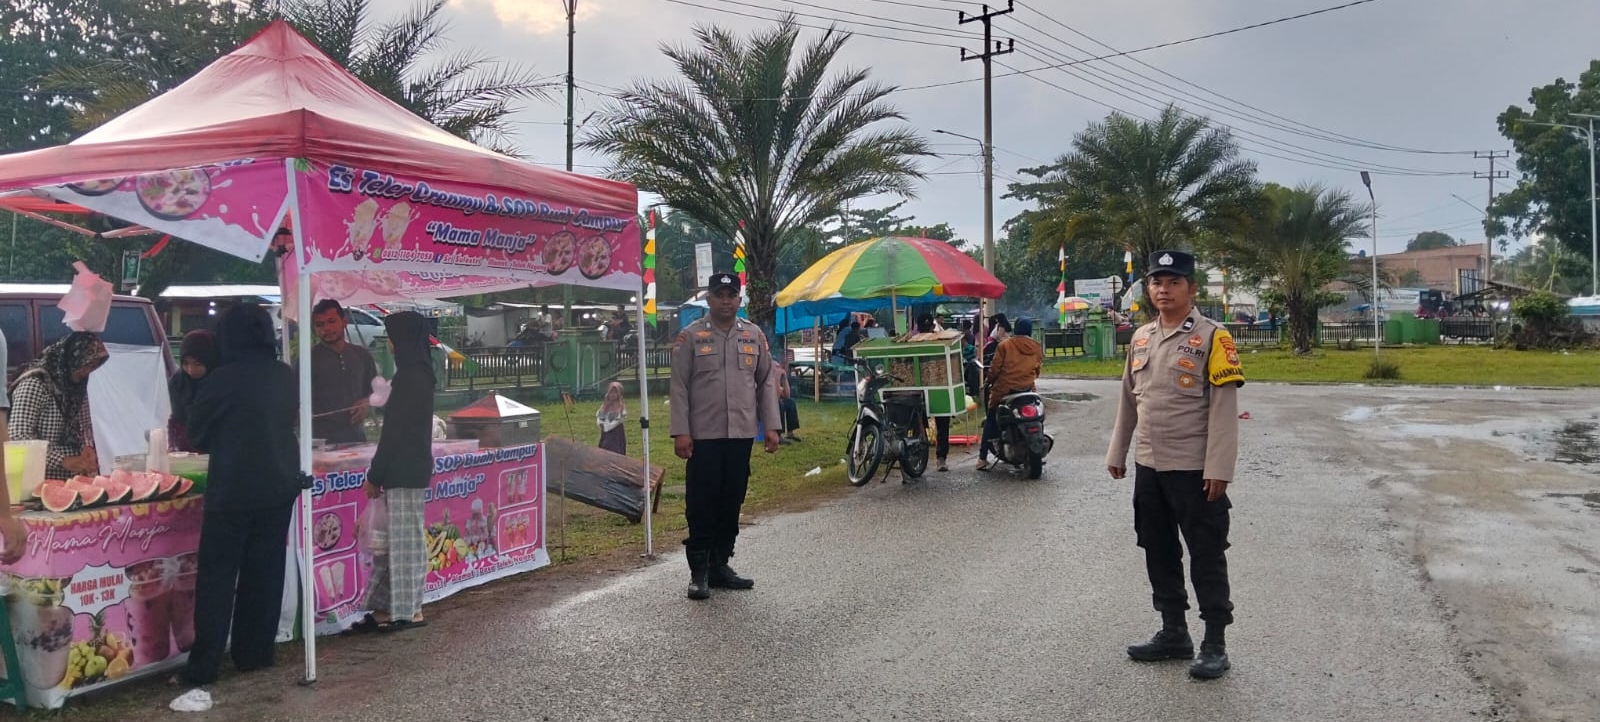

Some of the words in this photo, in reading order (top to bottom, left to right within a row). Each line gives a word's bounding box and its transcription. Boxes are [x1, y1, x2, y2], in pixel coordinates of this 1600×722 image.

[328, 164, 354, 192] Es
[358, 170, 412, 197] Teler
[484, 194, 499, 214] &
[1177, 345, 1205, 358] POLRI
[435, 455, 464, 472] SOP
[327, 471, 364, 493] Teler
[27, 526, 96, 561] Mama
[99, 516, 169, 550] Manja
[70, 578, 98, 594] HARGA
[99, 573, 124, 587] MULAI
[80, 594, 95, 606] 10K
[101, 589, 115, 602] 13K
